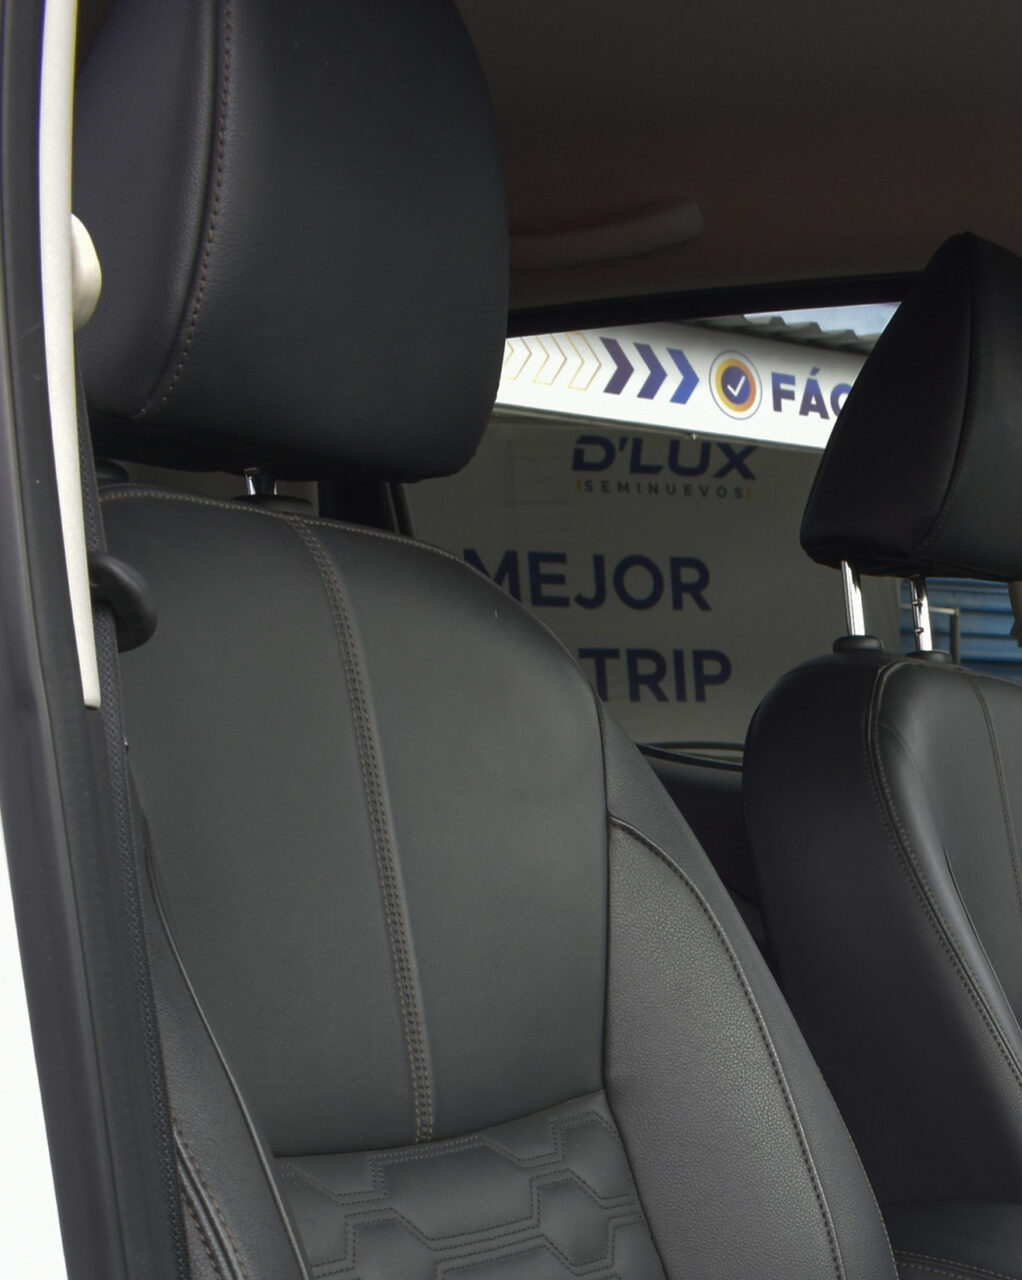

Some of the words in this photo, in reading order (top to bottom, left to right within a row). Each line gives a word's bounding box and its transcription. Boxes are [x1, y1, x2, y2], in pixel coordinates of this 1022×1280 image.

[572, 435, 758, 480] D'LUX
[584, 479, 744, 499] SEMINUEVOS
[463, 547, 712, 612] MEJOR
[578, 648, 732, 703] TRIP
